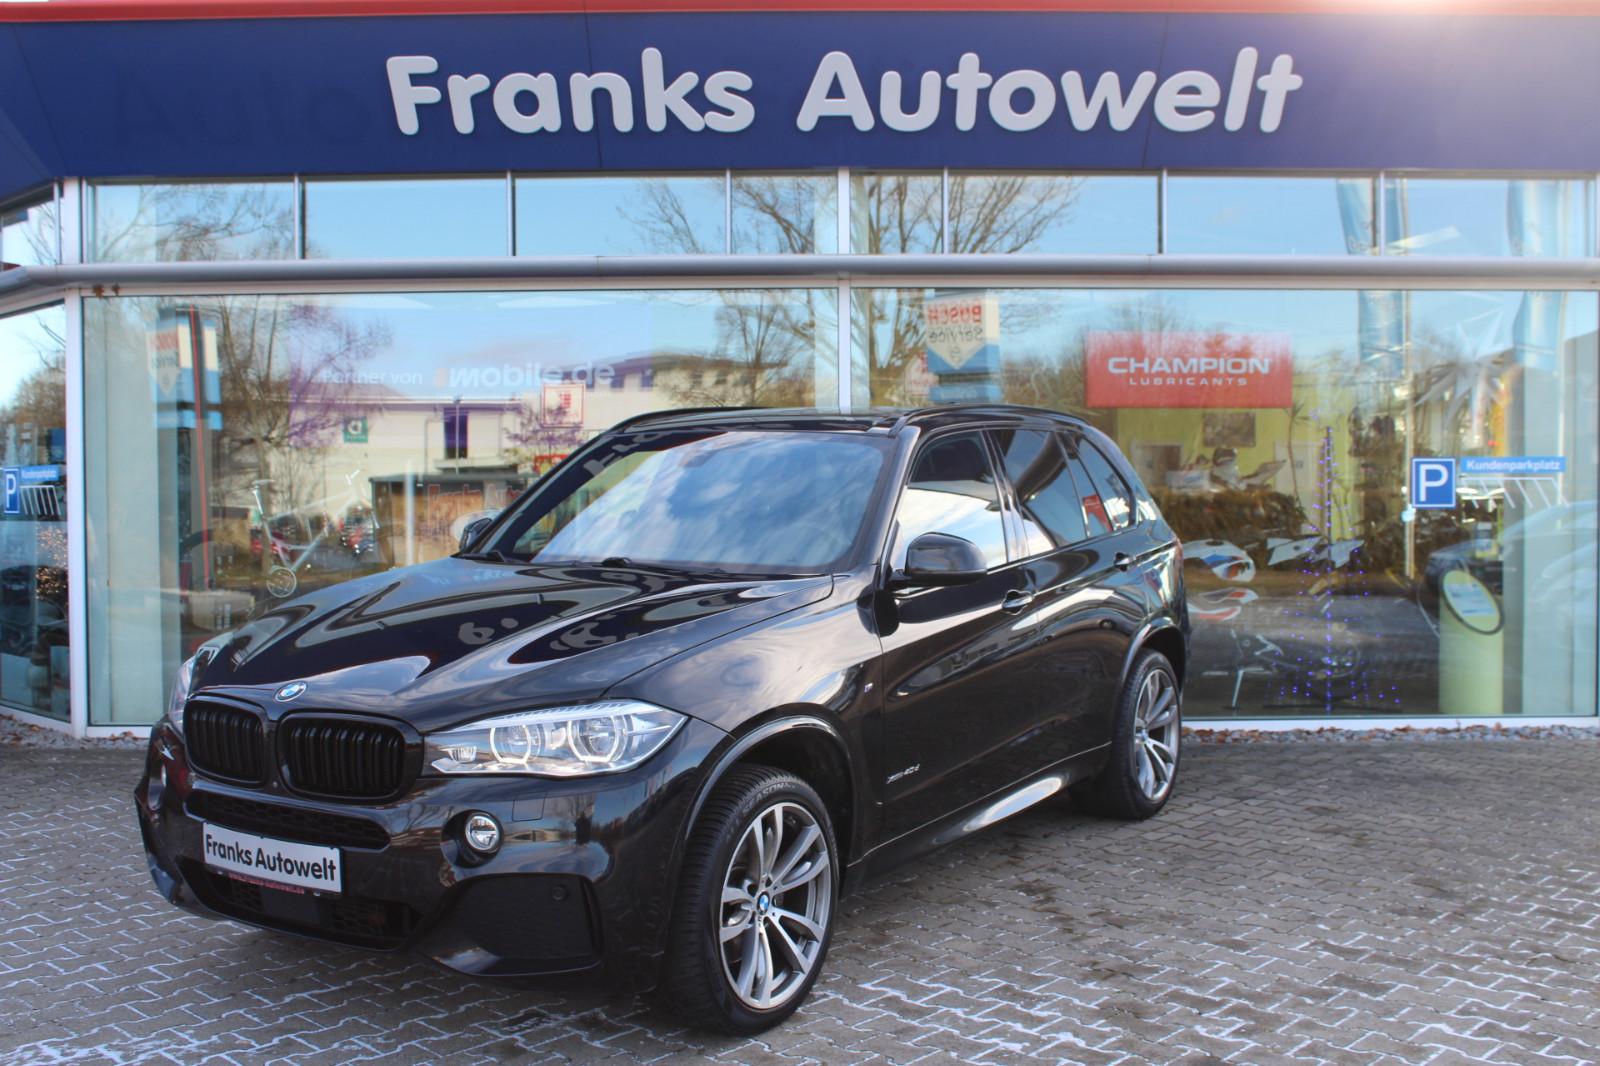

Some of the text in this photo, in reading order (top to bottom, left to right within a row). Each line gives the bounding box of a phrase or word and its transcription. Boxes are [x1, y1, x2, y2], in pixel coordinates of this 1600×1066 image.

[386, 46, 1303, 135] Franks Autowelt
[391, 371, 423, 385] von
[449, 360, 616, 387] mobile.de
[1107, 356, 1270, 374] CHAMPION
[1128, 377, 1248, 386] LUBRICANTS
[1466, 459, 1561, 471] Kundenparkplatz
[1419, 463, 1449, 502] P
[205, 833, 336, 881] Franks Autowelt
